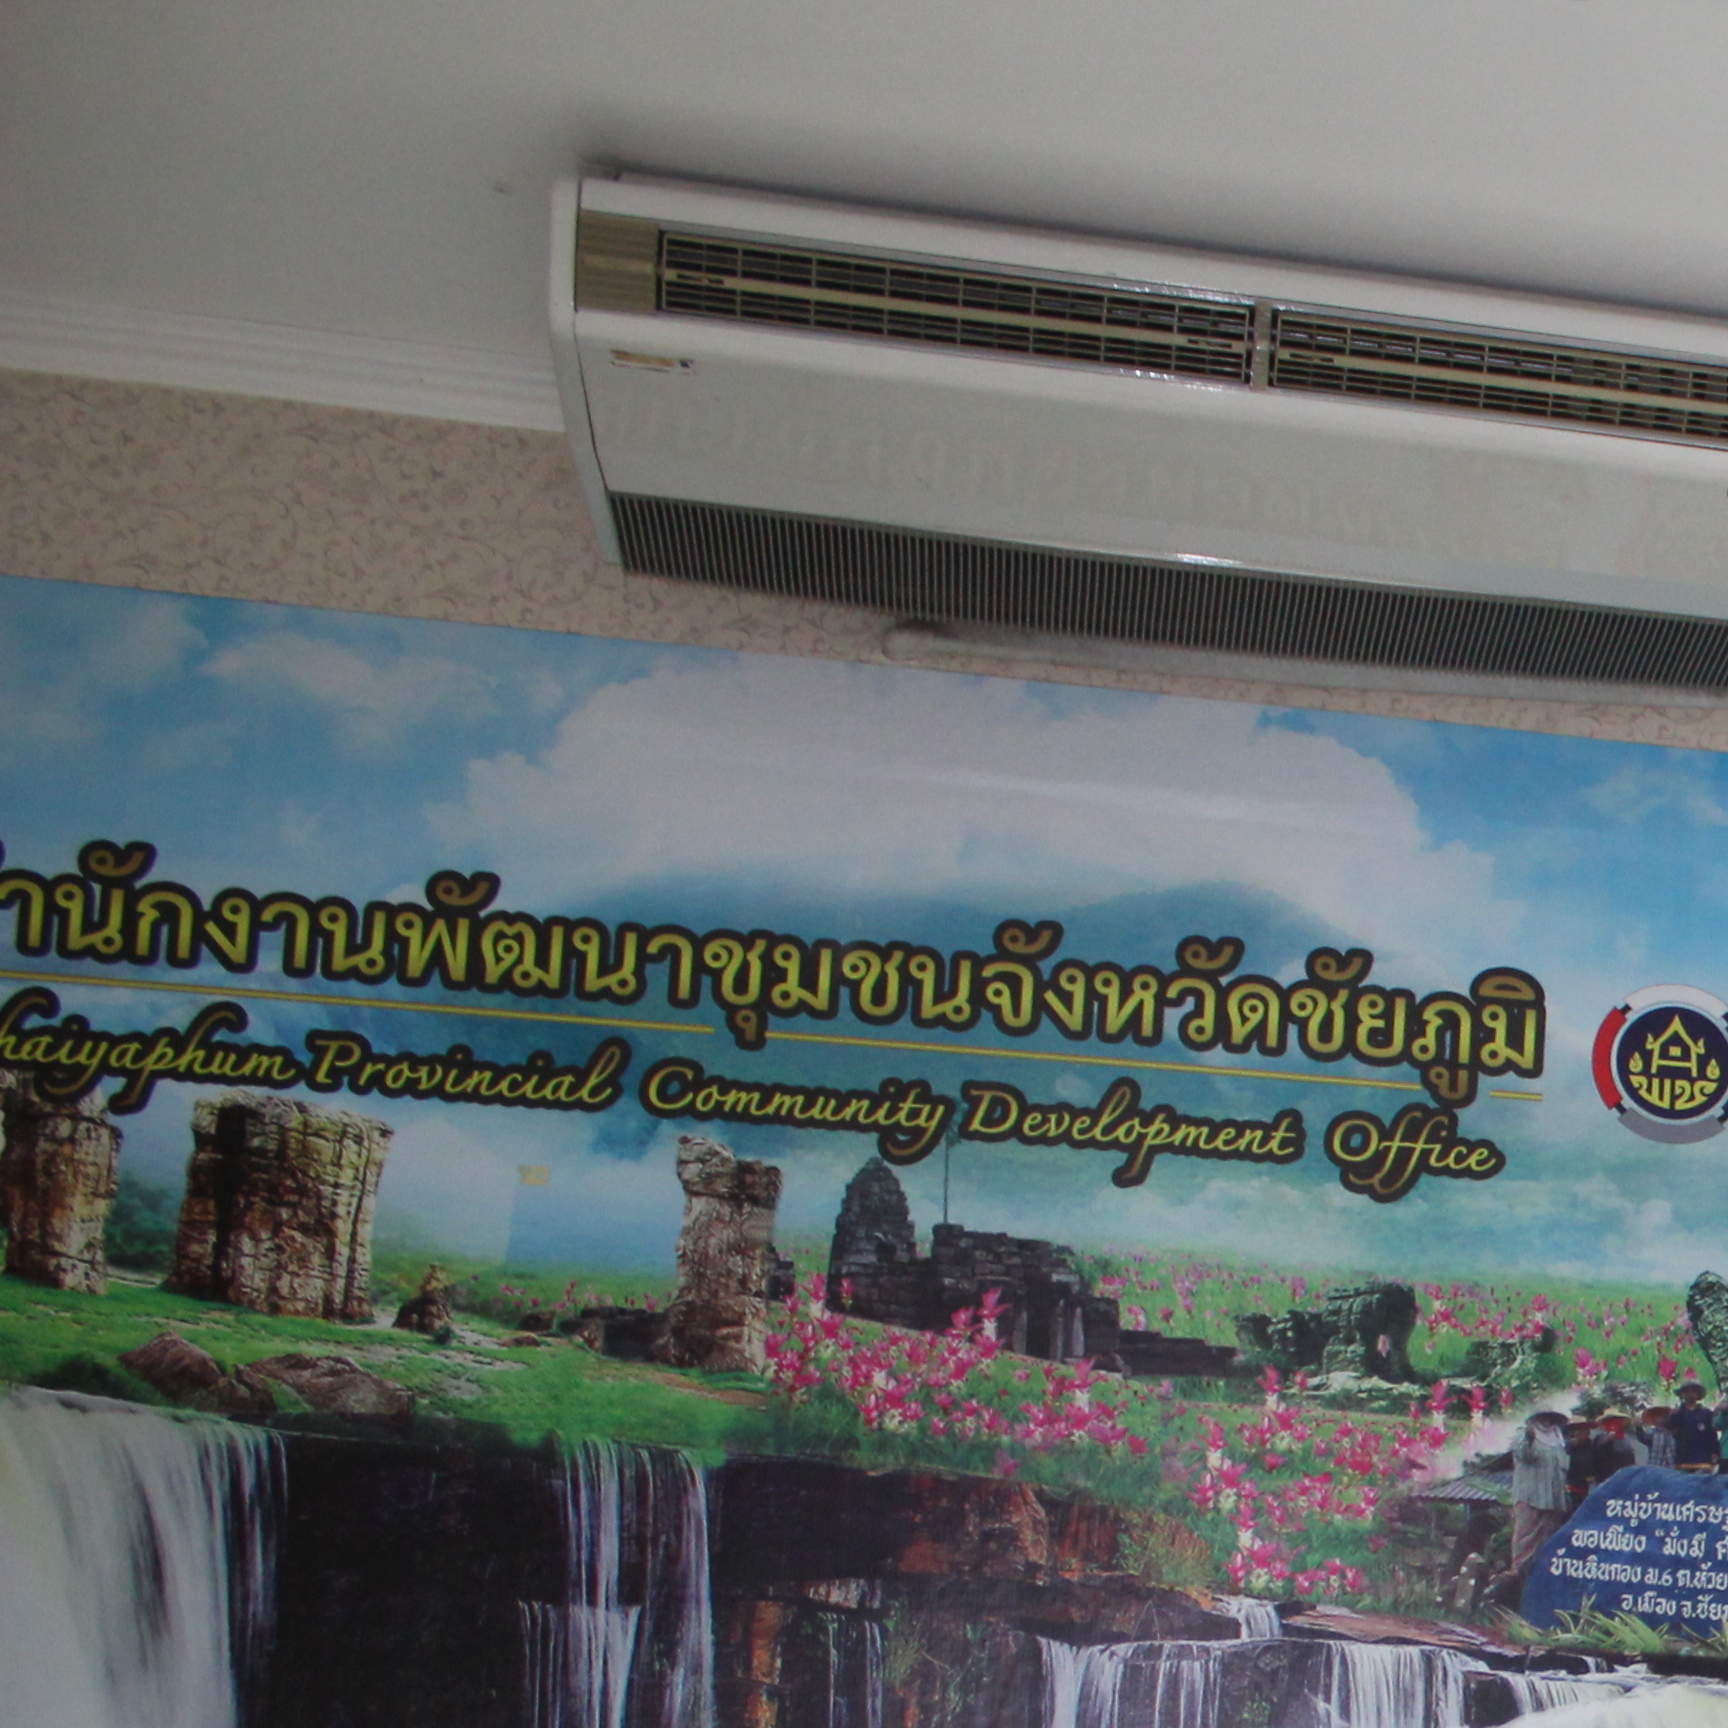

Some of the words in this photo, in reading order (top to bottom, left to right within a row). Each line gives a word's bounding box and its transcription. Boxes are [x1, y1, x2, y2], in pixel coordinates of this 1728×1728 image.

[0, 842, 1546, 1106] ำนักงานพัฒนาชุมชนจังหวัดชัยภูมิ
[0, 990, 301, 1108] haiyaphum
[310, 1034, 628, 1110] Provincial
[642, 1062, 946, 1162] Community
[966, 1080, 1298, 1184] Development
[1330, 1106, 1502, 1198] Office
